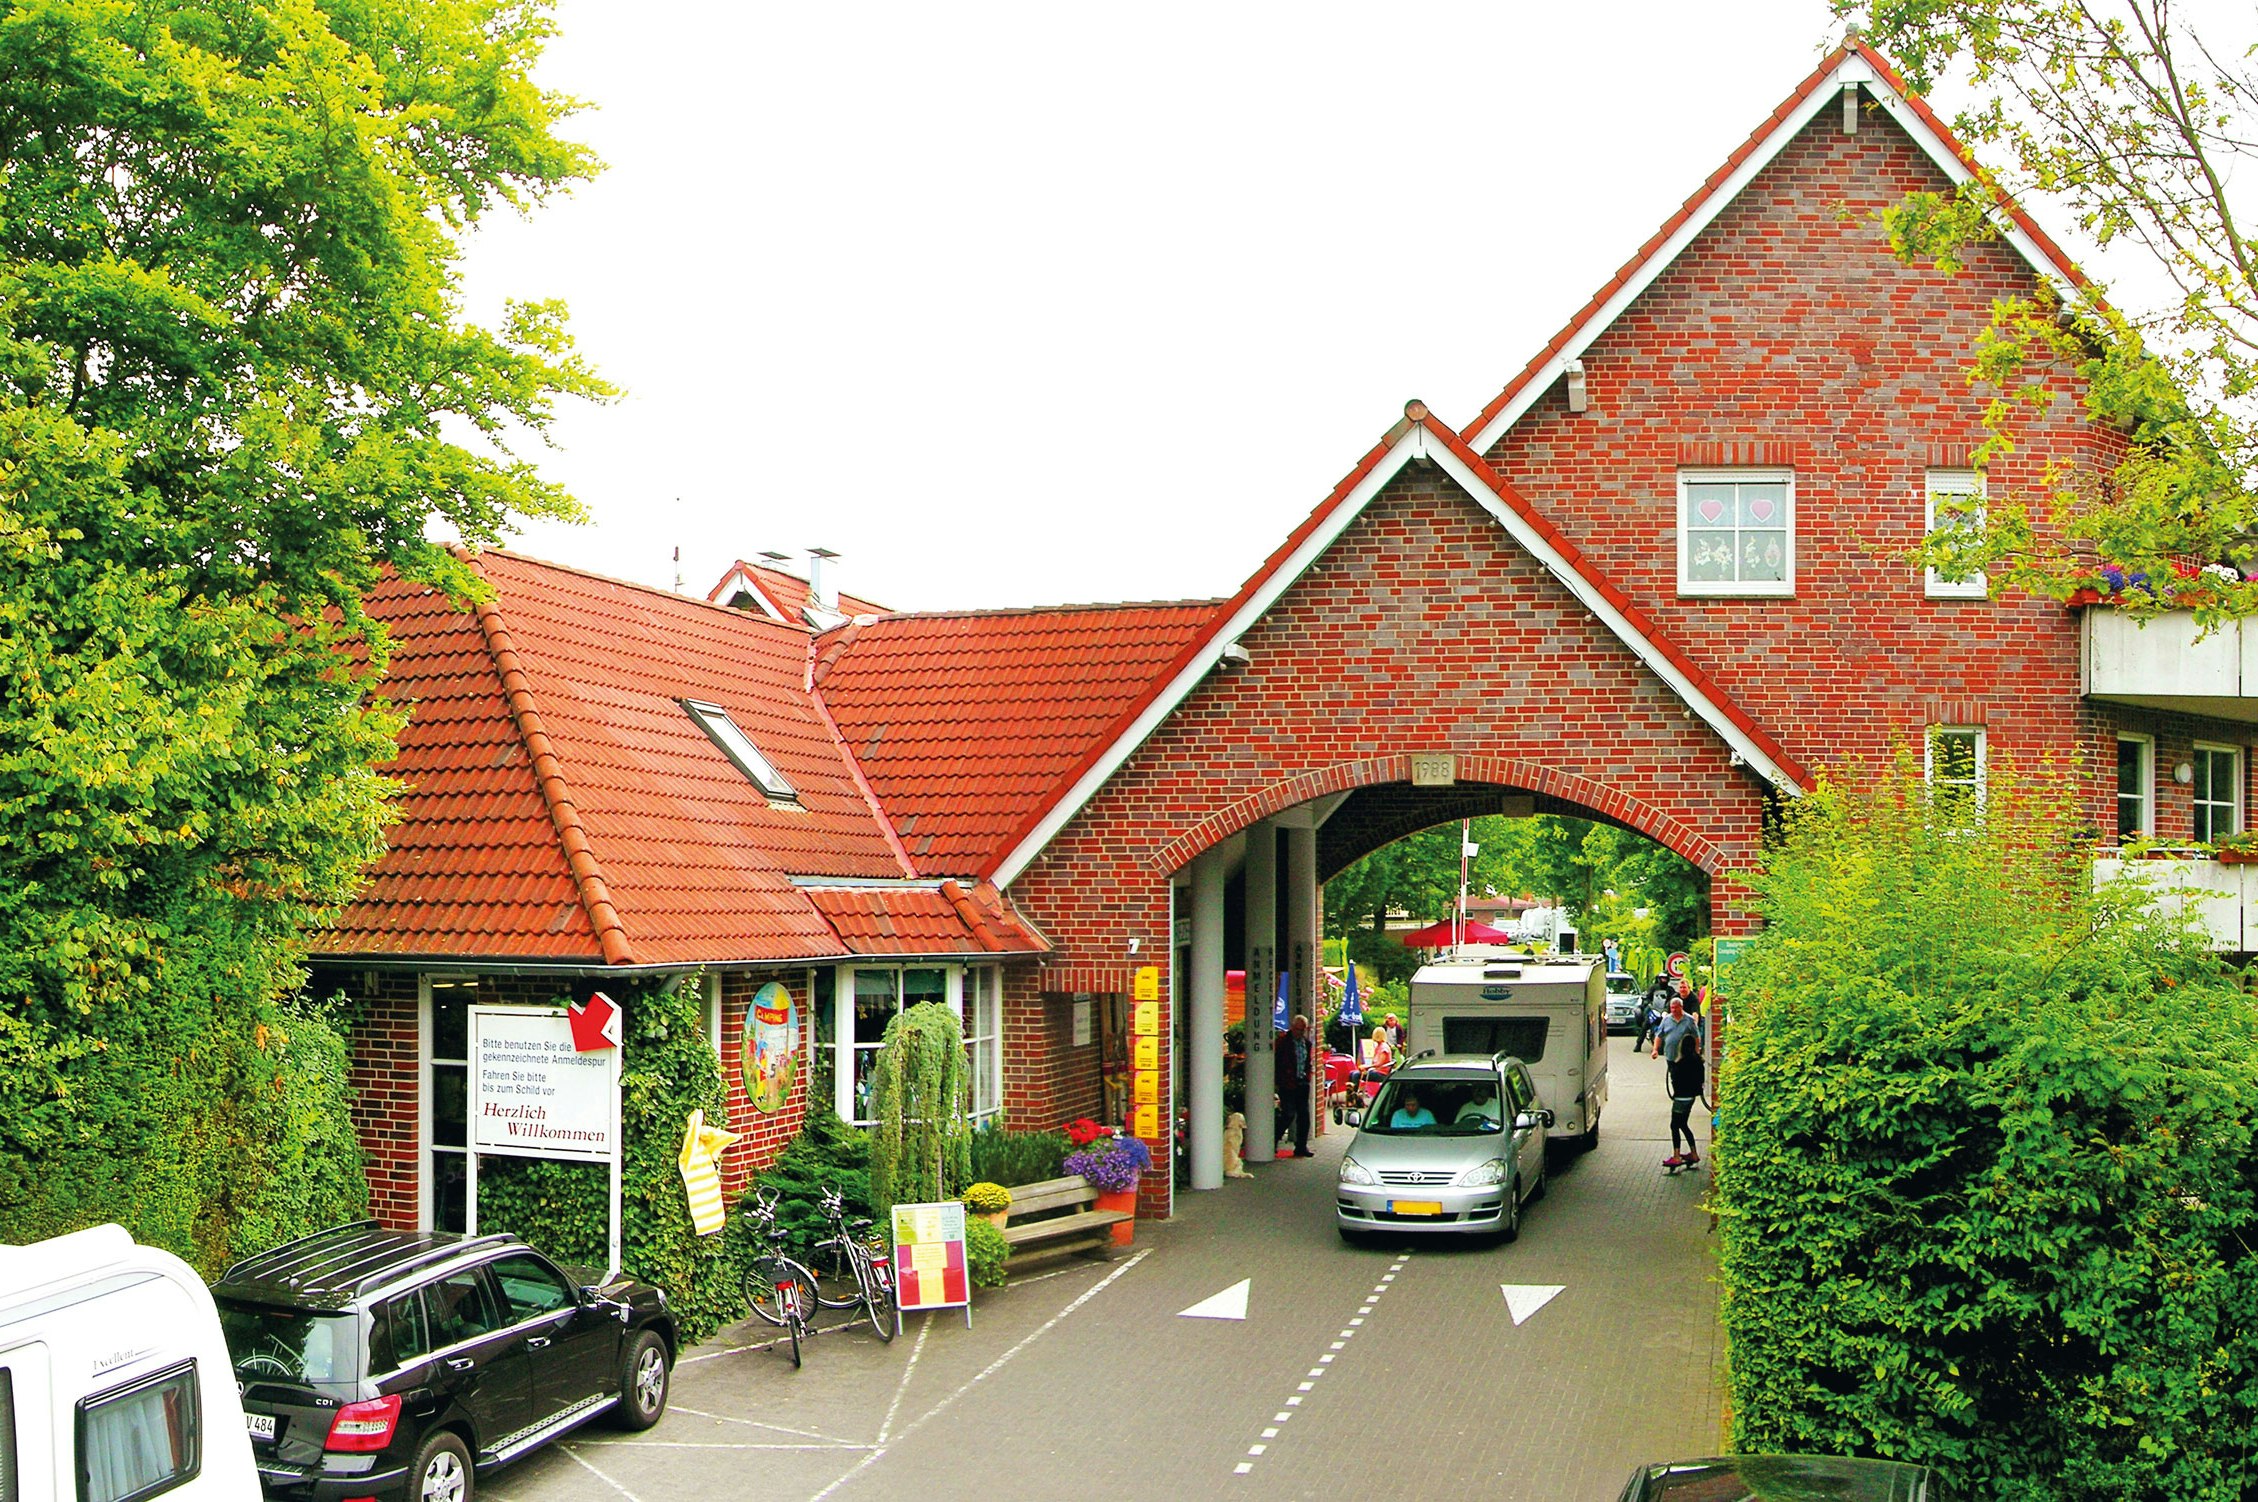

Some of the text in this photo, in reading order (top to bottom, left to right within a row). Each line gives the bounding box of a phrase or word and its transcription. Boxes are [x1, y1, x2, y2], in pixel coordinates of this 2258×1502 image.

[1128, 938, 1140, 954] 7
[1253, 947, 1261, 1052] ANMELDUNG
[483, 1038, 572, 1051] Bitte benutzen Sie die
[483, 1052, 606, 1067] gekennzeichnete Anmeldespur
[482, 1070, 546, 1083] Fahren Sie bitte
[482, 1083, 555, 1096] bis zum Schild vor
[484, 1102, 546, 1120] Herzlich
[507, 1122, 606, 1142] Willkommen
[315, 1398, 334, 1407] CDI
[254, 1417, 273, 1433] 484
